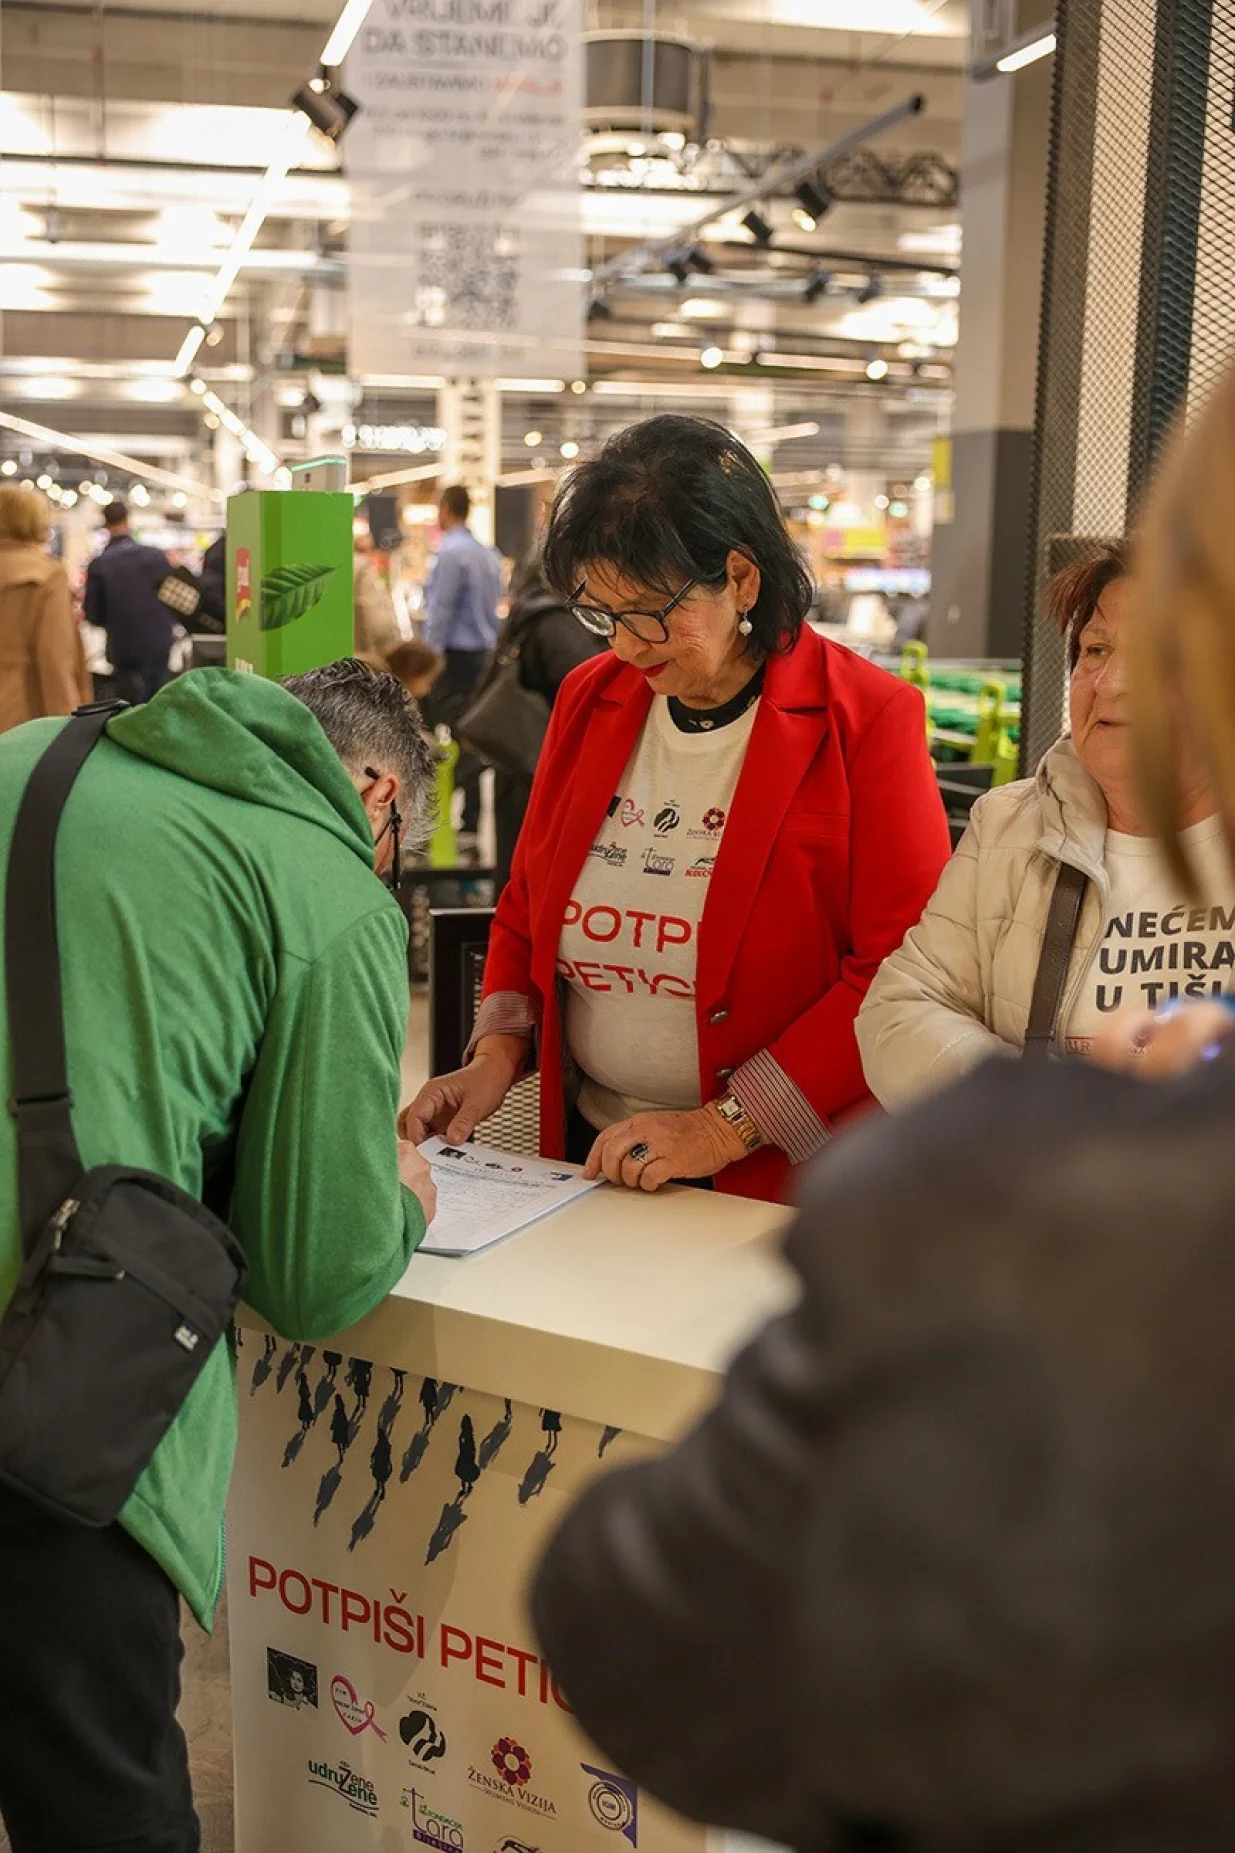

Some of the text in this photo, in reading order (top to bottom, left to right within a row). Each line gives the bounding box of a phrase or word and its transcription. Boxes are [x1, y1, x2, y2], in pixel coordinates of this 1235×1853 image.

[562, 899, 702, 953] POTP
[1099, 941, 1235, 975] UMIRA
[1095, 984, 1123, 1013] U
[249, 1555, 425, 1659] POTPIŠI
[467, 1765, 515, 1798] ŽENSKA
[517, 1787, 557, 1815] VIZIJA
